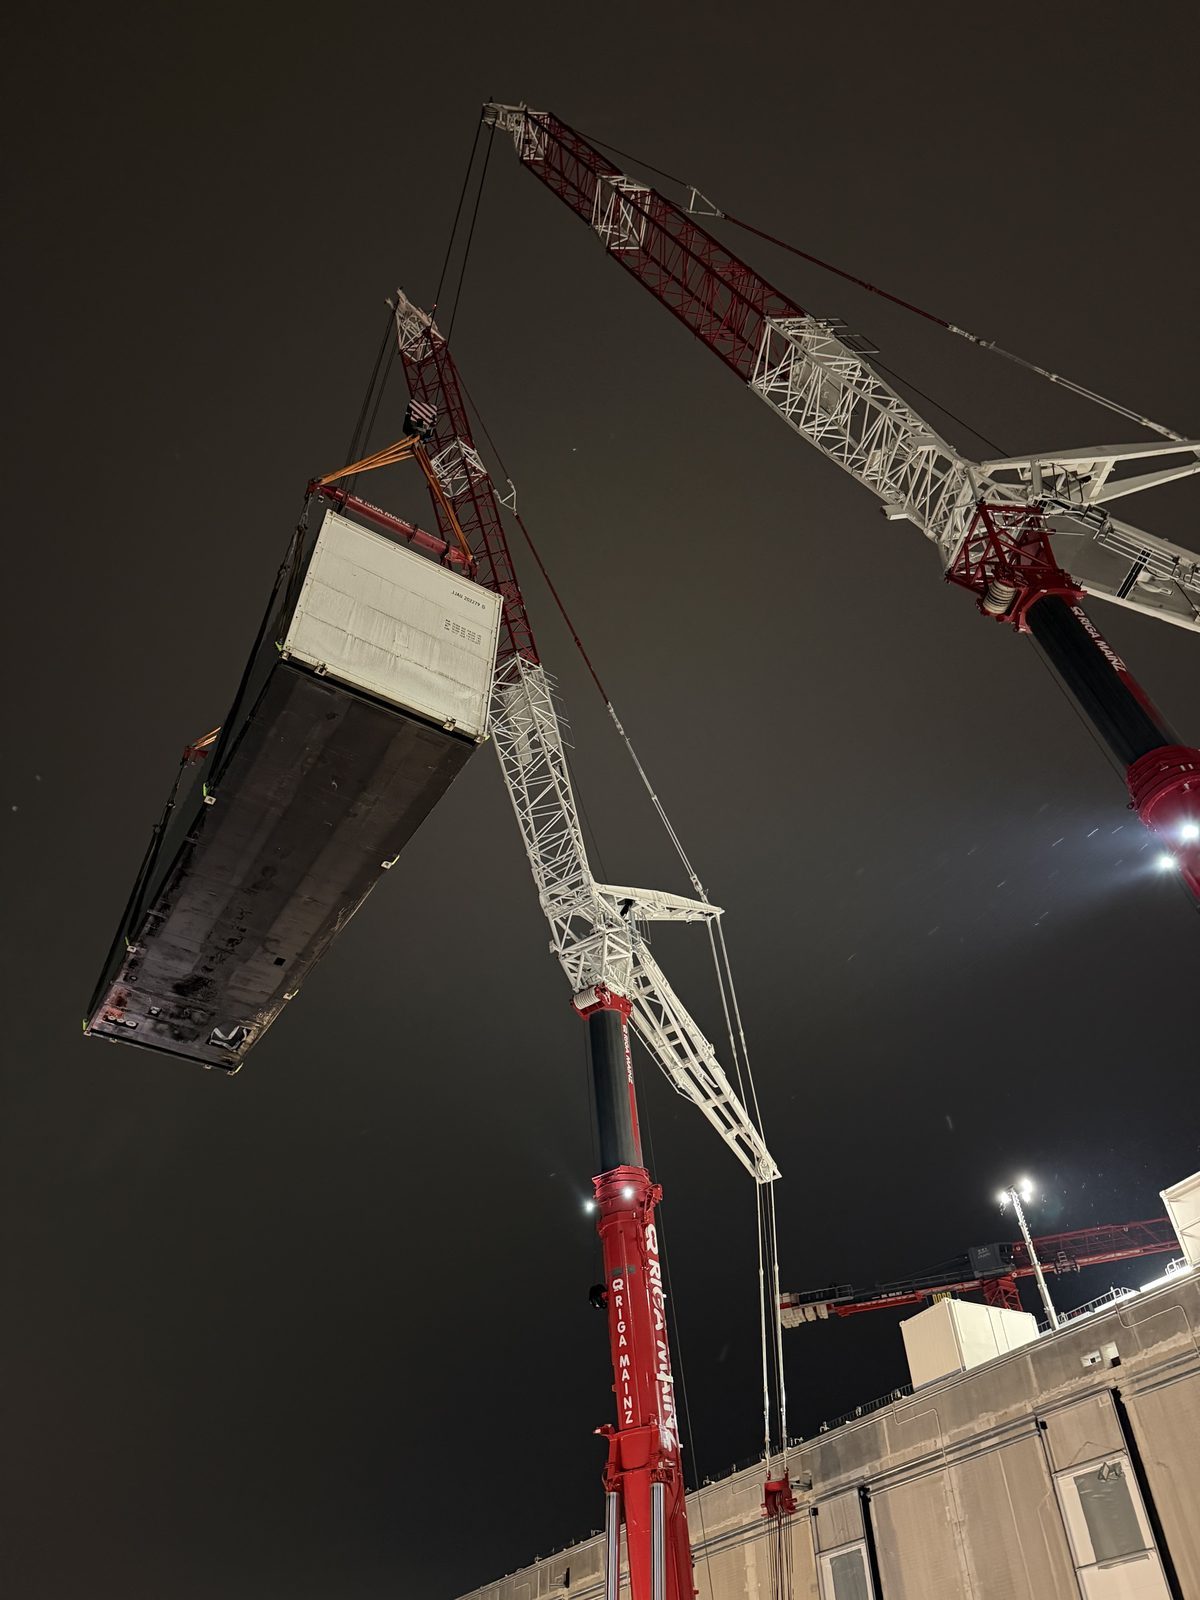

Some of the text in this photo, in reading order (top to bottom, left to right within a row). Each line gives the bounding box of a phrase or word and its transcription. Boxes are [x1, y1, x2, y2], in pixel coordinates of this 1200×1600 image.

[1078, 616, 1127, 672] RIGA MAINZ
[615, 1295, 633, 1424] RIGA MAINZ
[648, 1259, 678, 1452] RIGA MAINZ
